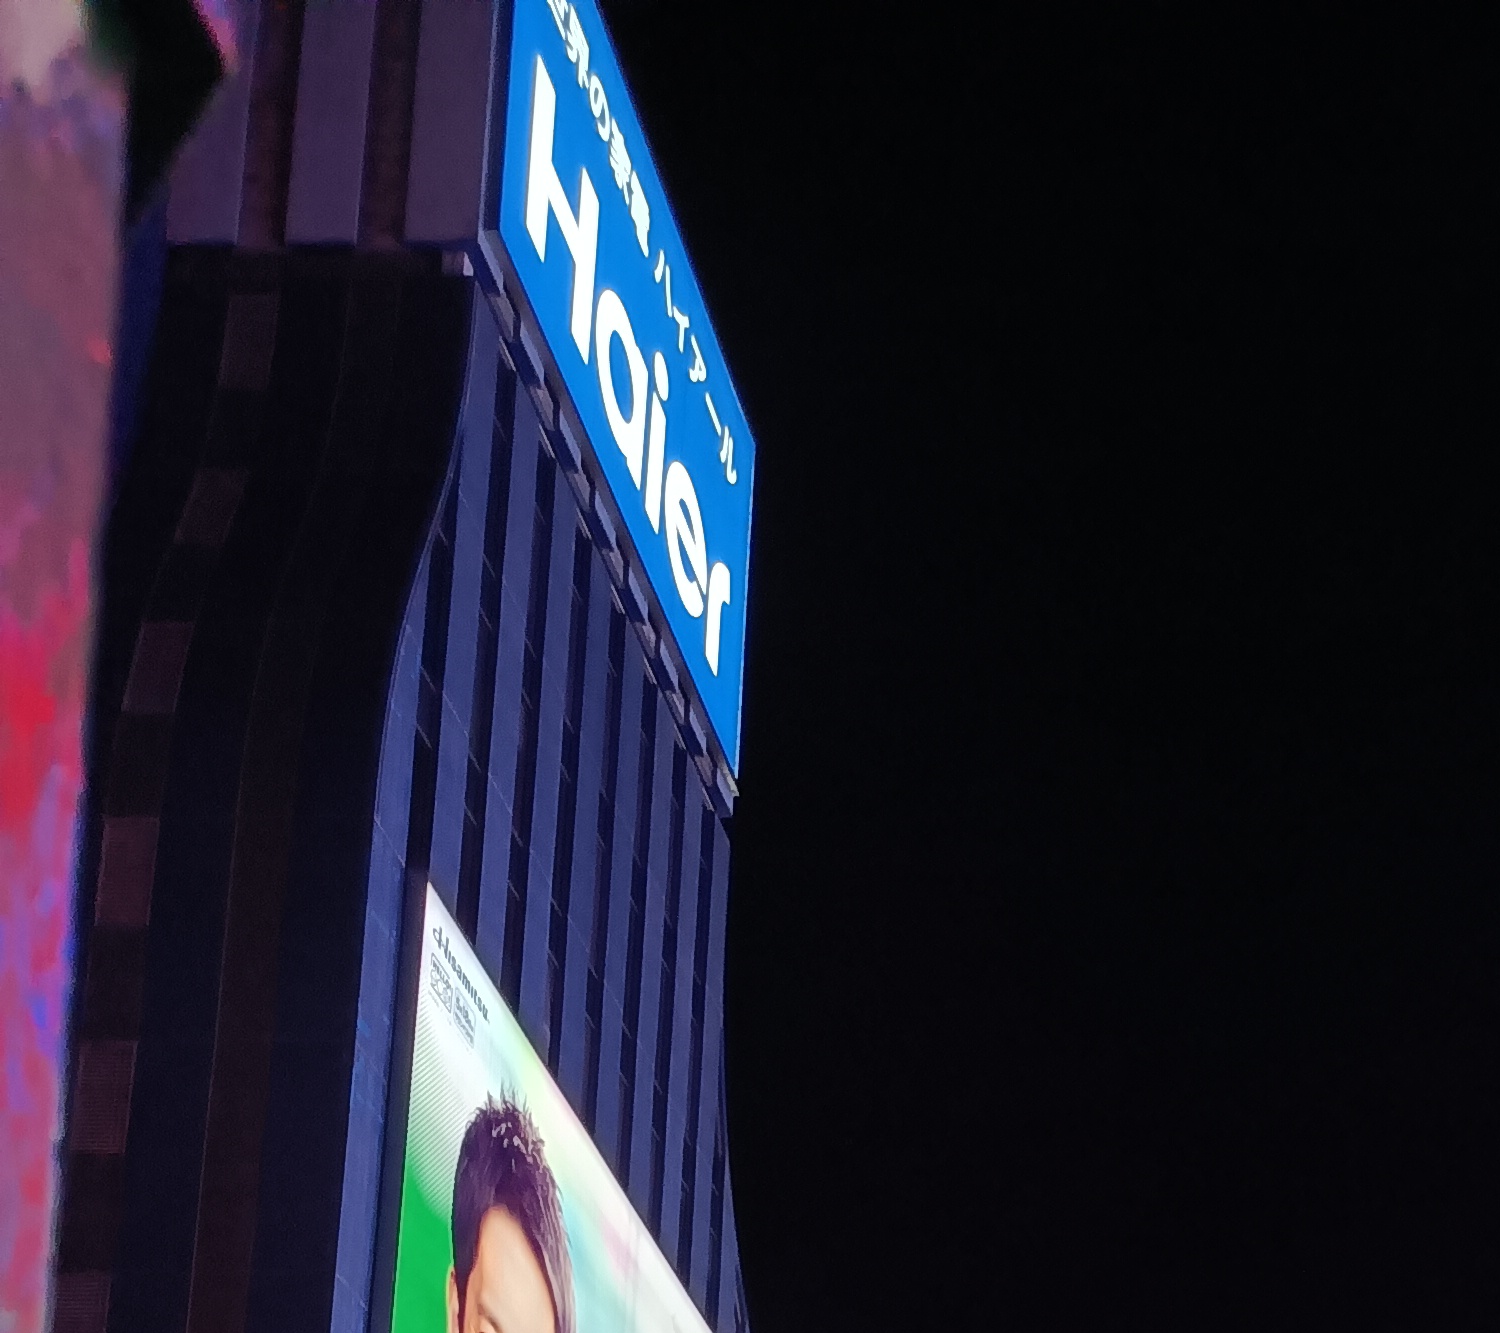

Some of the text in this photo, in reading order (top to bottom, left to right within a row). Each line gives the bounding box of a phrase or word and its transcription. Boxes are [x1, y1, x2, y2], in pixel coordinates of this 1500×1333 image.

[525, 54, 731, 677] Haier
[654, 249, 737, 485] ハイアール
